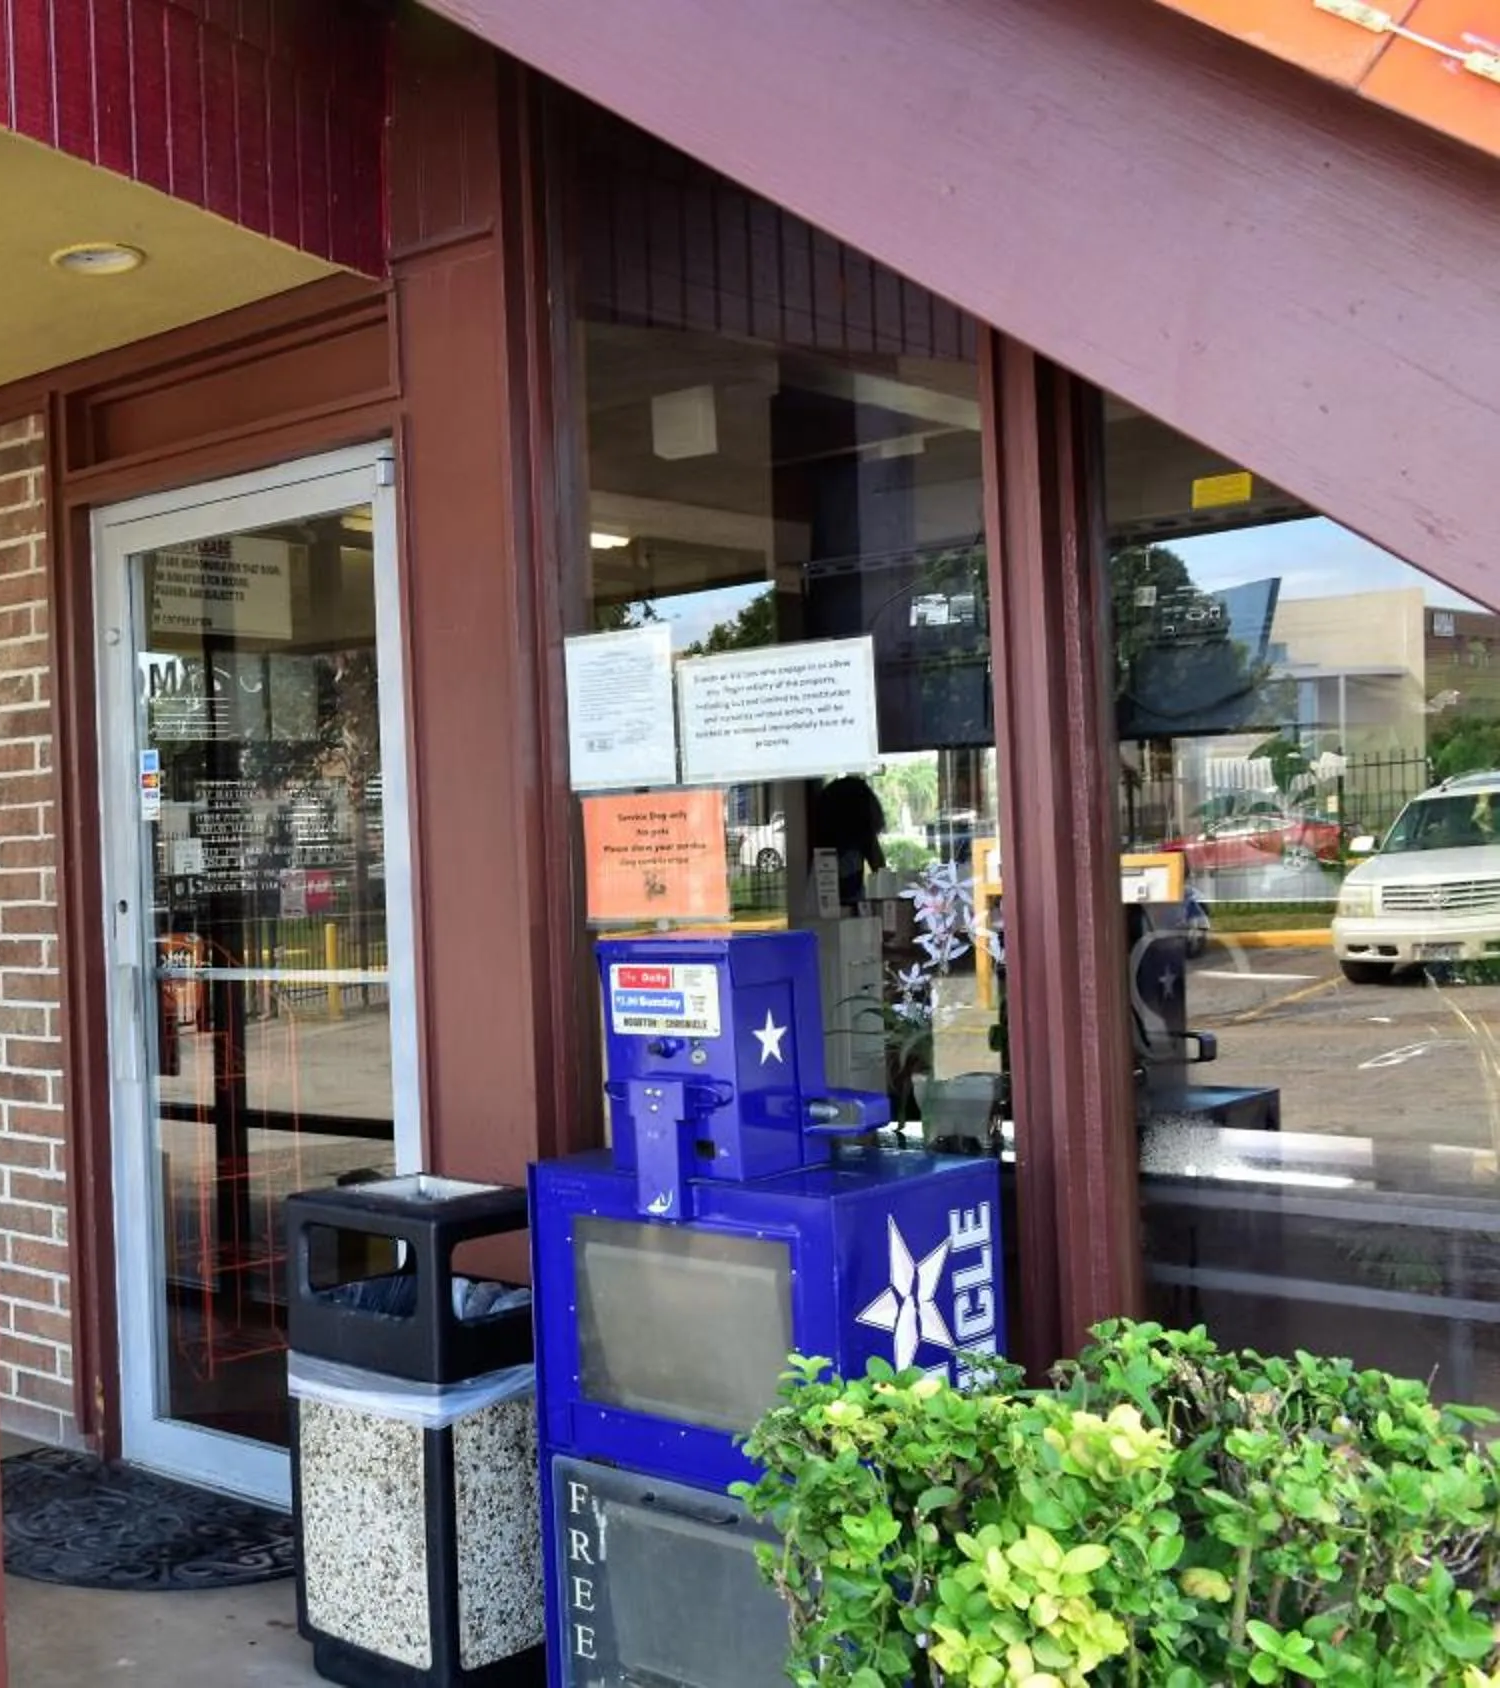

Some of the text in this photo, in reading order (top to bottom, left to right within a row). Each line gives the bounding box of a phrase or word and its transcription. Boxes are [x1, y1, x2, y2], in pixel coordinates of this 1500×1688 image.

[640, 971, 668, 987] Daily
[639, 995, 681, 1010] Sunday
[567, 1480, 598, 1661] FREE
